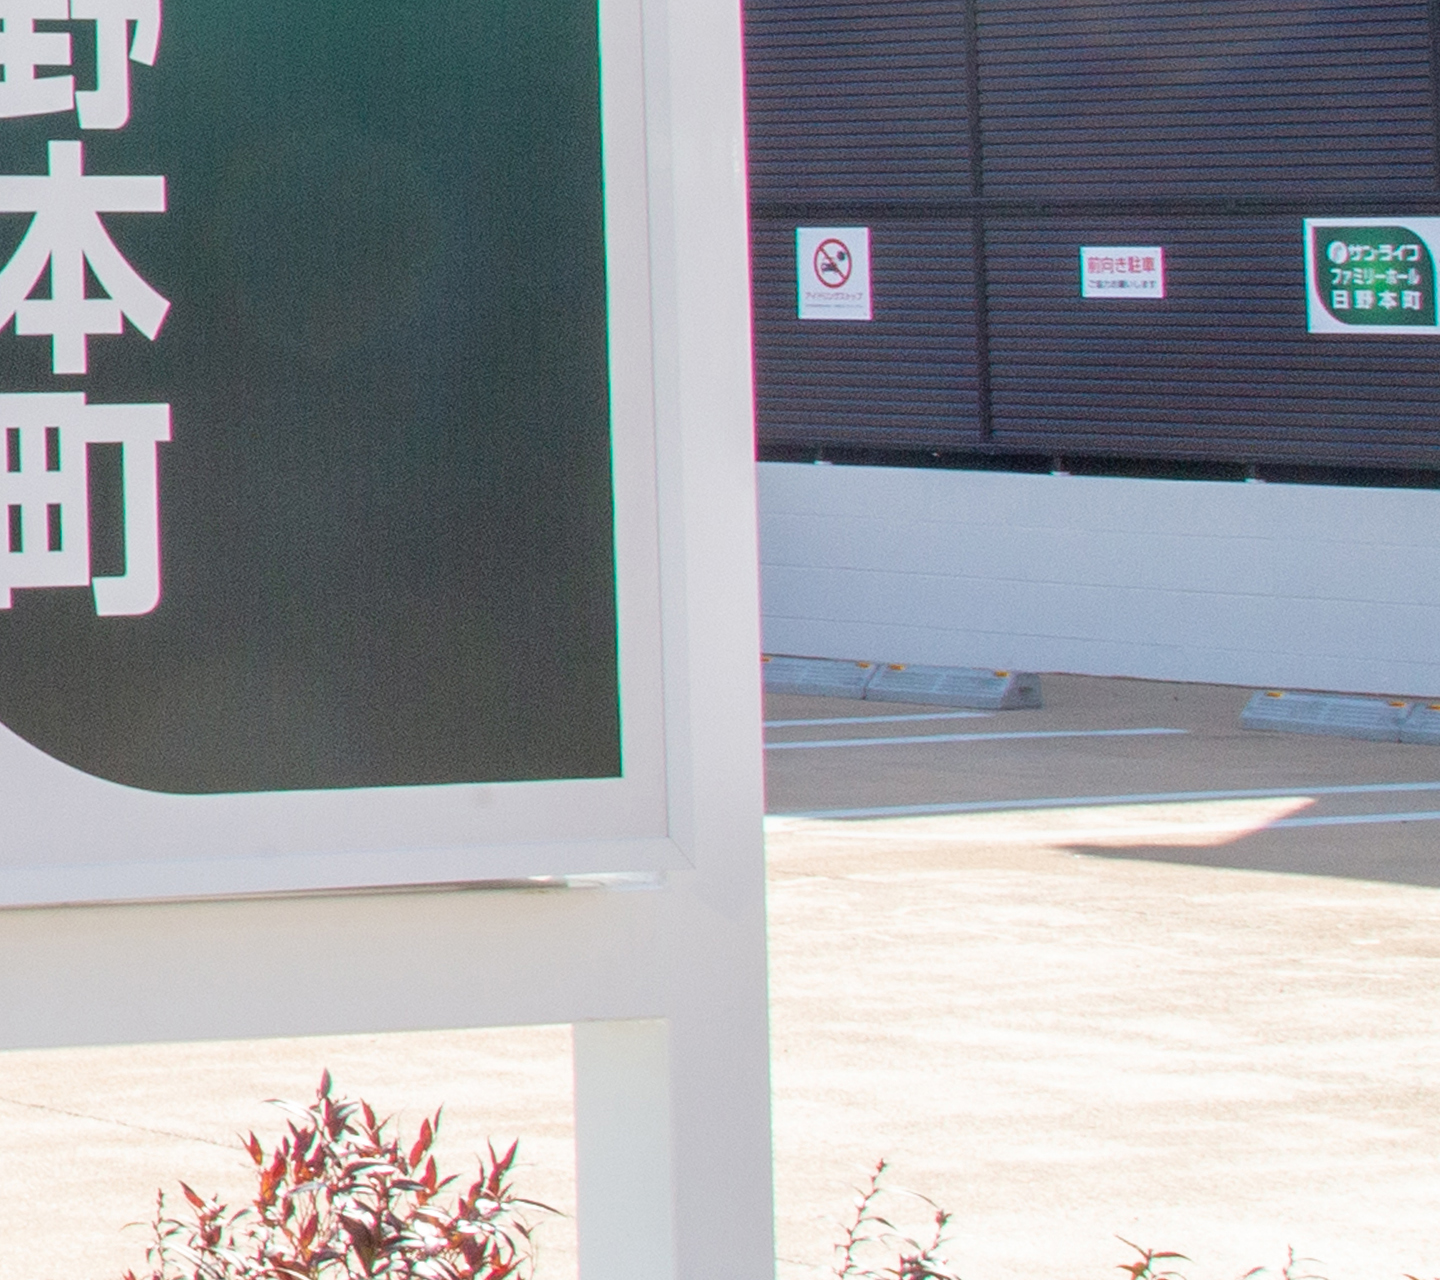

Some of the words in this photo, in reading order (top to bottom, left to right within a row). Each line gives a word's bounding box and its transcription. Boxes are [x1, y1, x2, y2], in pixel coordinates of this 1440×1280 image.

[1087, 256, 1156, 274] 前向き駐車
[1329, 267, 1421, 286] ファミリーホール
[1331, 289, 1423, 311] 日野本町
